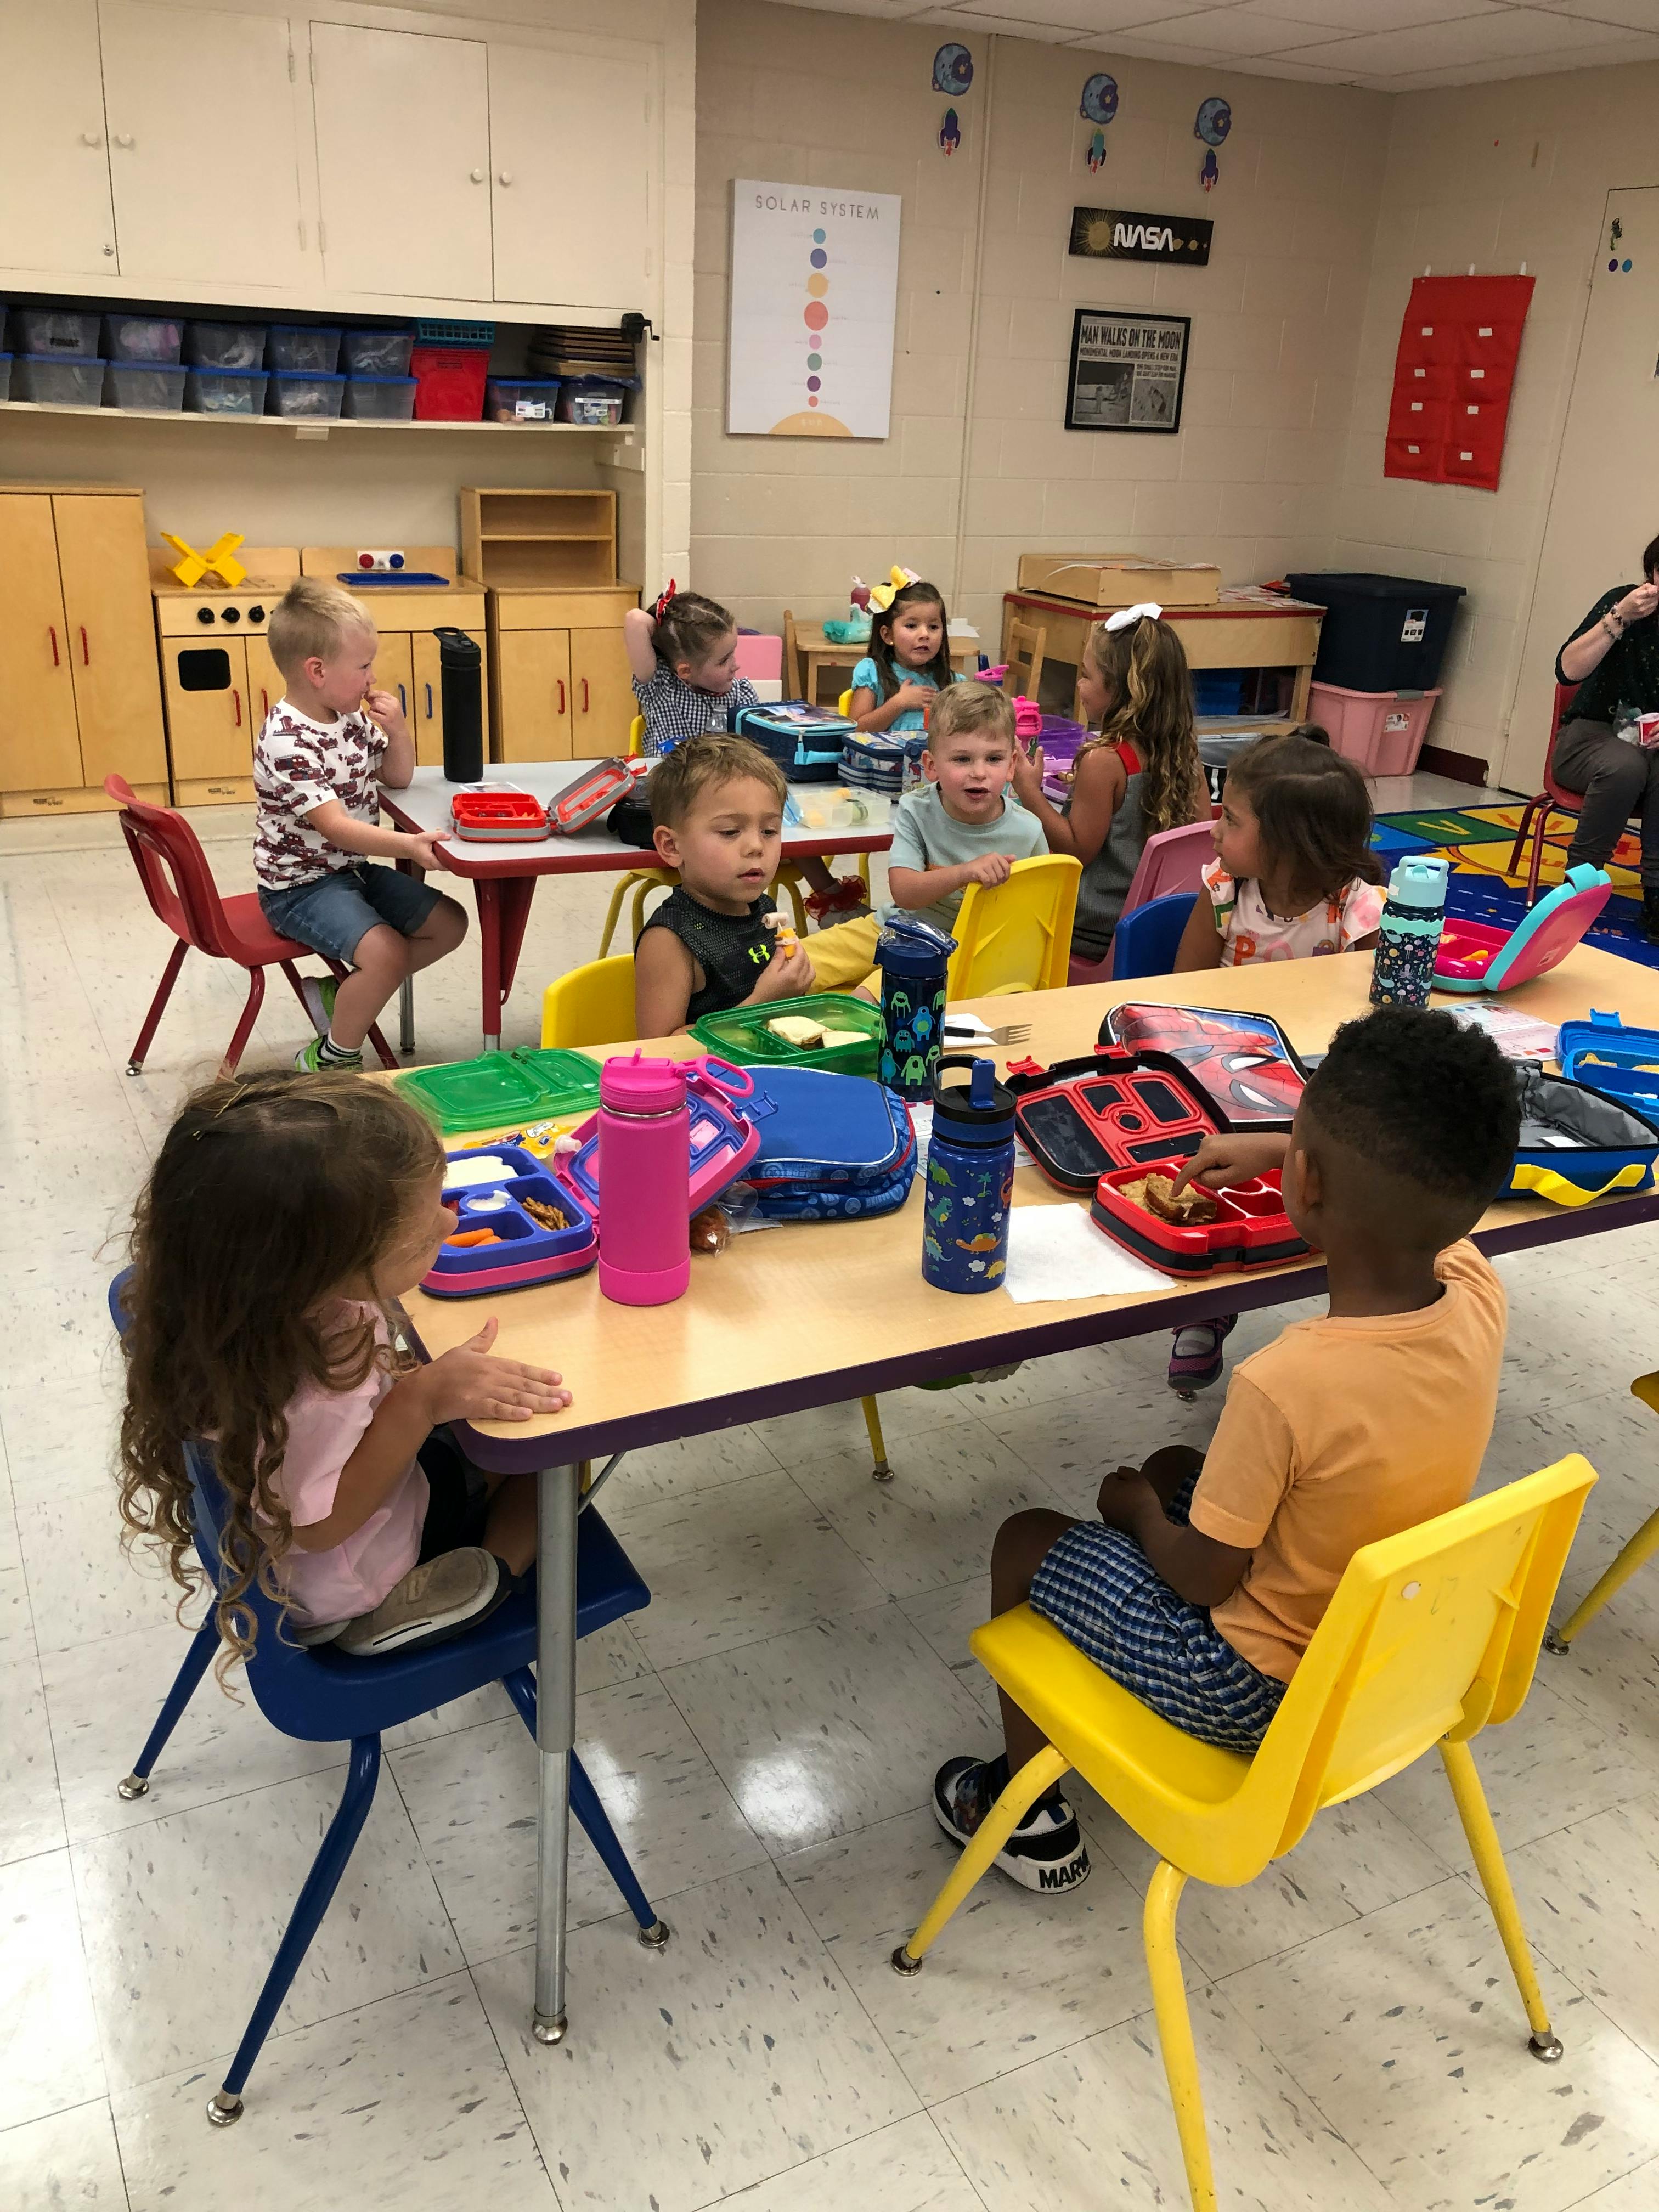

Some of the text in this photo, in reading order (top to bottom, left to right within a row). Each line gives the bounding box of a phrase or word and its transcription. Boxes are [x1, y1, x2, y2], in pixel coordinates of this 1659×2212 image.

[755, 195, 879, 221] SOLAR SYSTEM
[1113, 223, 1174, 252] NASA
[1080, 325, 1182, 350] MAN WALKS ON THE MOON
